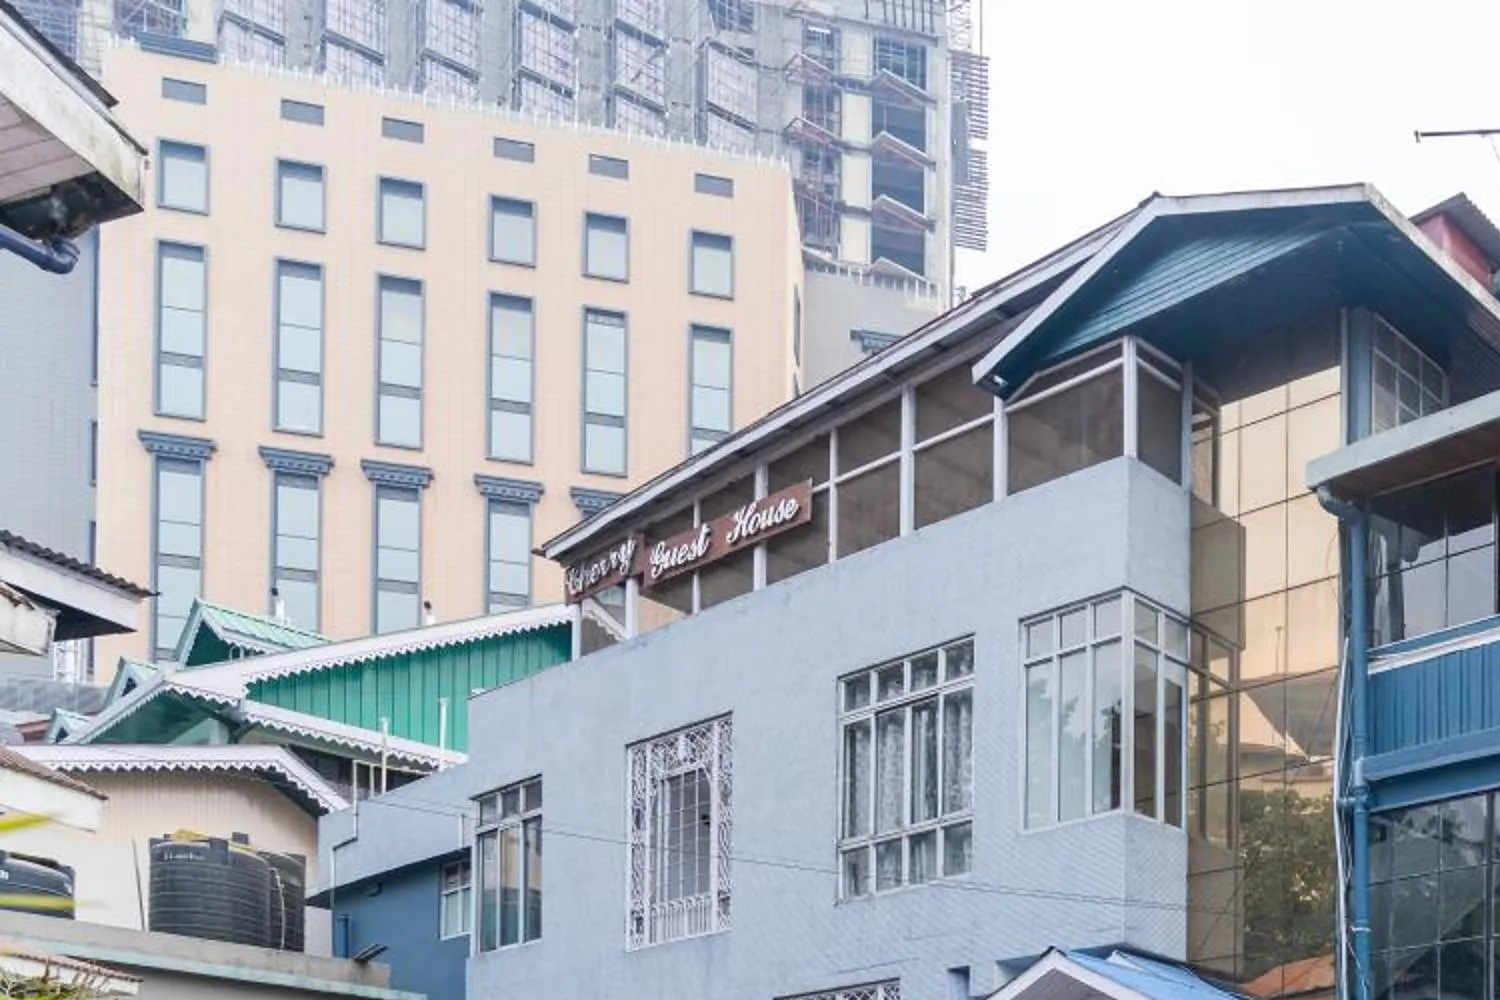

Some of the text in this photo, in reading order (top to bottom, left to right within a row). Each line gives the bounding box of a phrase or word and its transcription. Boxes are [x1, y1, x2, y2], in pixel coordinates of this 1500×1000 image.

[566, 496, 799, 595] Cherry Guest House
